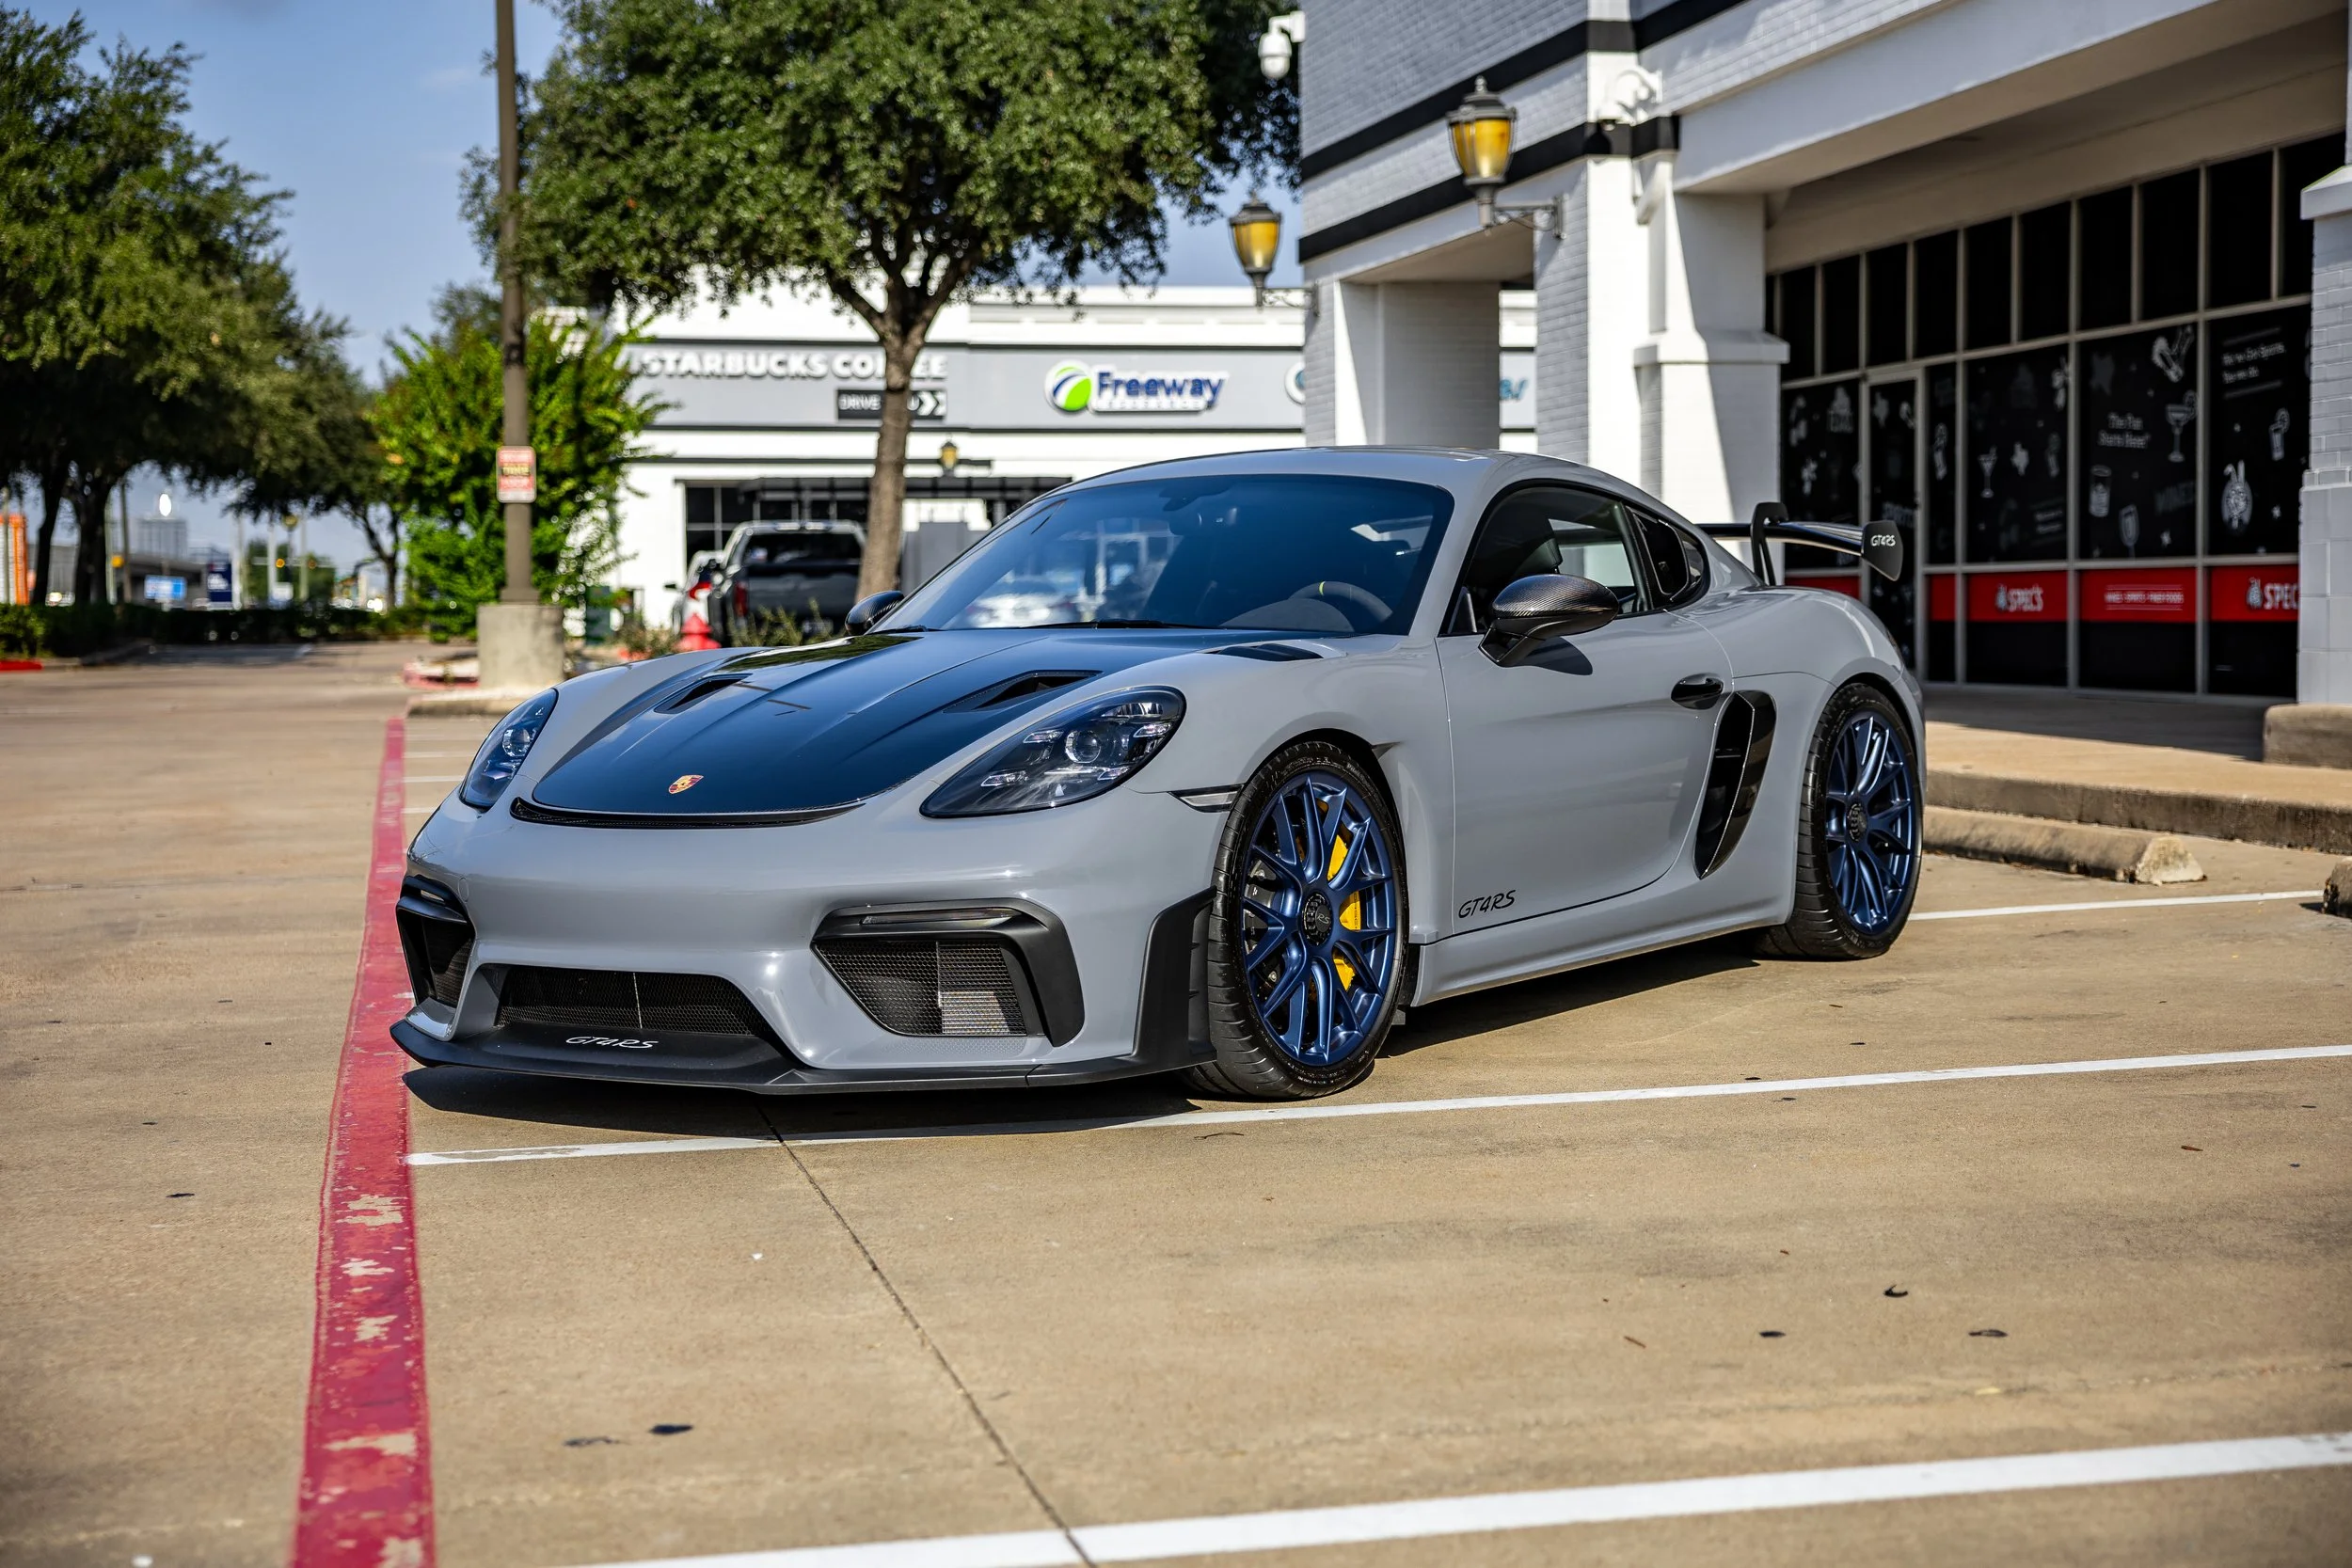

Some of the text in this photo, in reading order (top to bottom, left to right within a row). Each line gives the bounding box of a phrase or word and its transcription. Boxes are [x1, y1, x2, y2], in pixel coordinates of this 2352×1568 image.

[642, 352, 946, 378] STARBUCKS COEE
[1097, 371, 1227, 410] Freeway
[838, 393, 882, 411] DRIVE
[1458, 889, 1516, 918] GT4RS
[1317, 913, 1330, 925] RS
[565, 1036, 659, 1049] GT4RS
